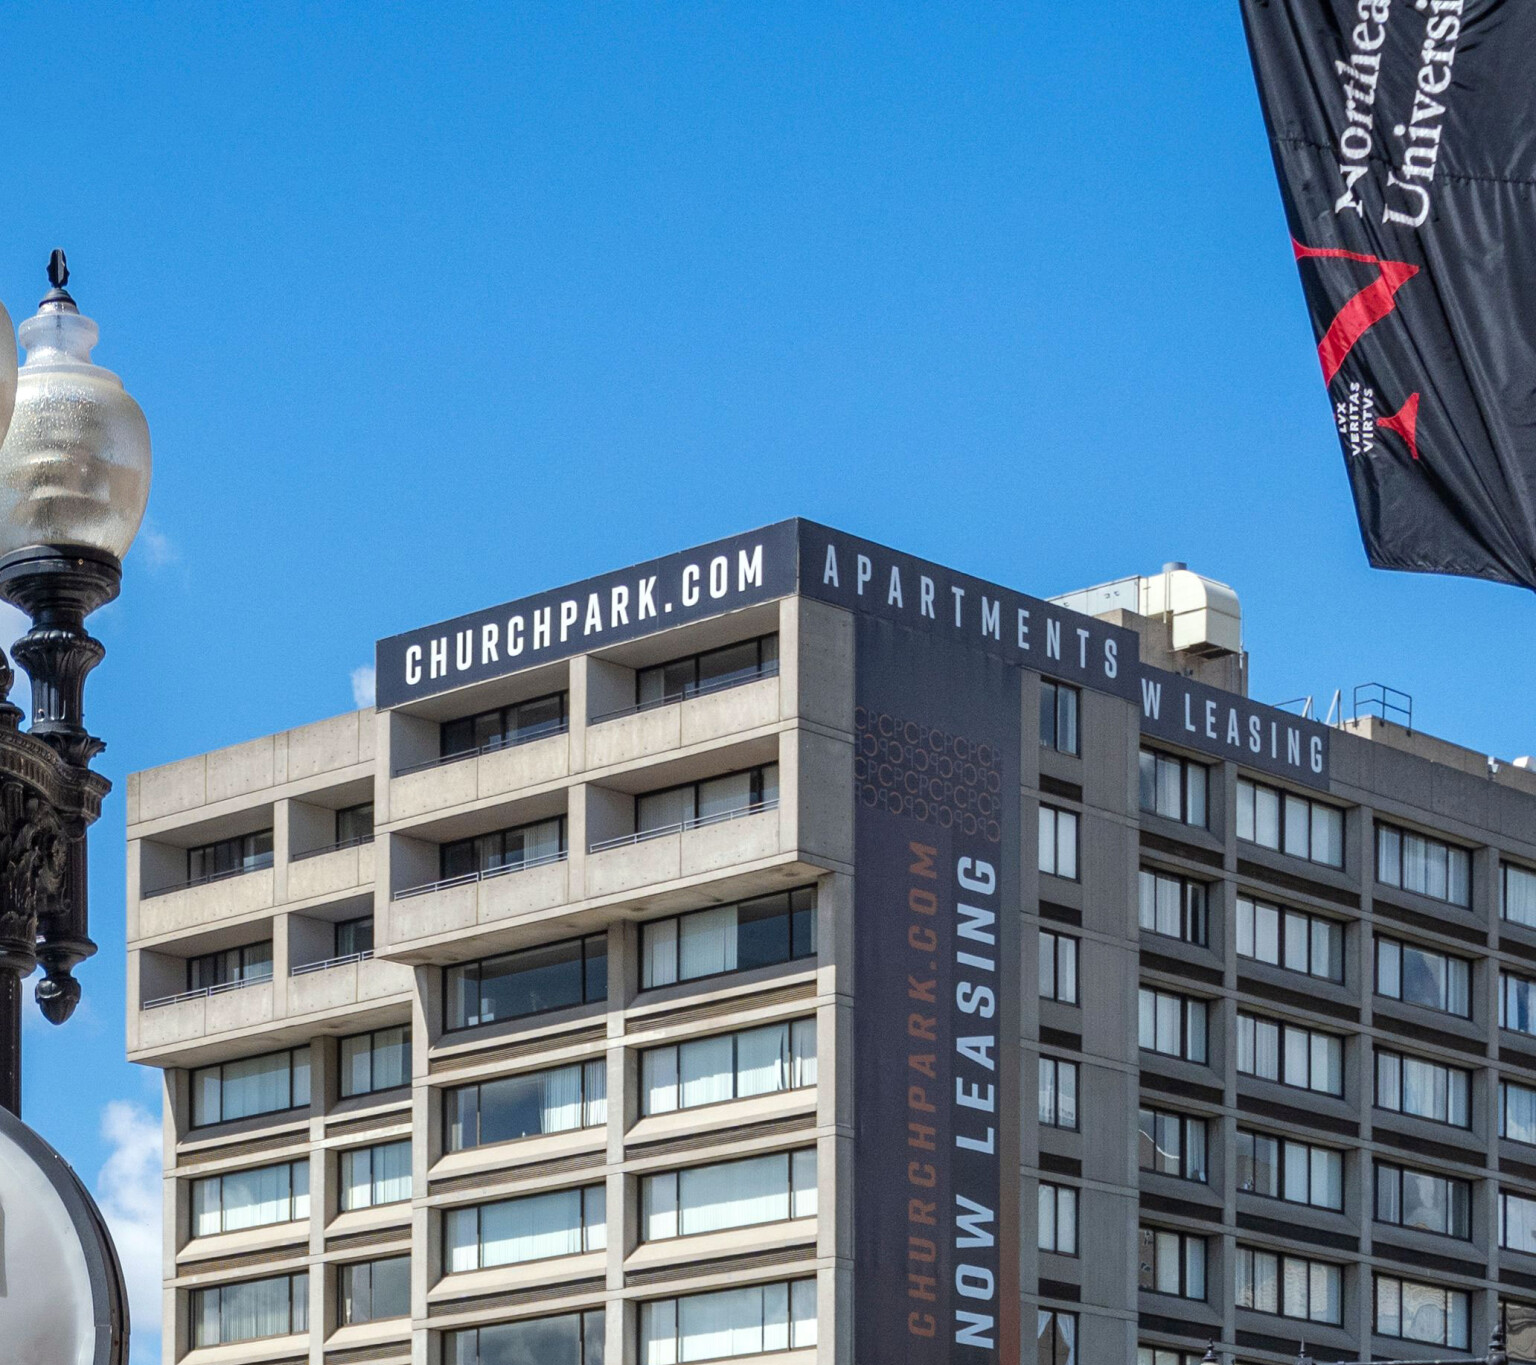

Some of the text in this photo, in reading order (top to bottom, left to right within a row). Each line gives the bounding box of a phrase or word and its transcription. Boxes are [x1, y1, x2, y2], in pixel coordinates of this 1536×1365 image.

[1337, 402, 1347, 434] LVX
[1349, 381, 1361, 457] VERITAS
[405, 544, 763, 686] CHURCHPARK.COM
[822, 544, 1119, 679] APARTMENTS
[1184, 692, 1323, 774] LEASING
[908, 841, 938, 1338] CHURCHPARK.COM
[955, 856, 997, 1350] NOW LEASING
